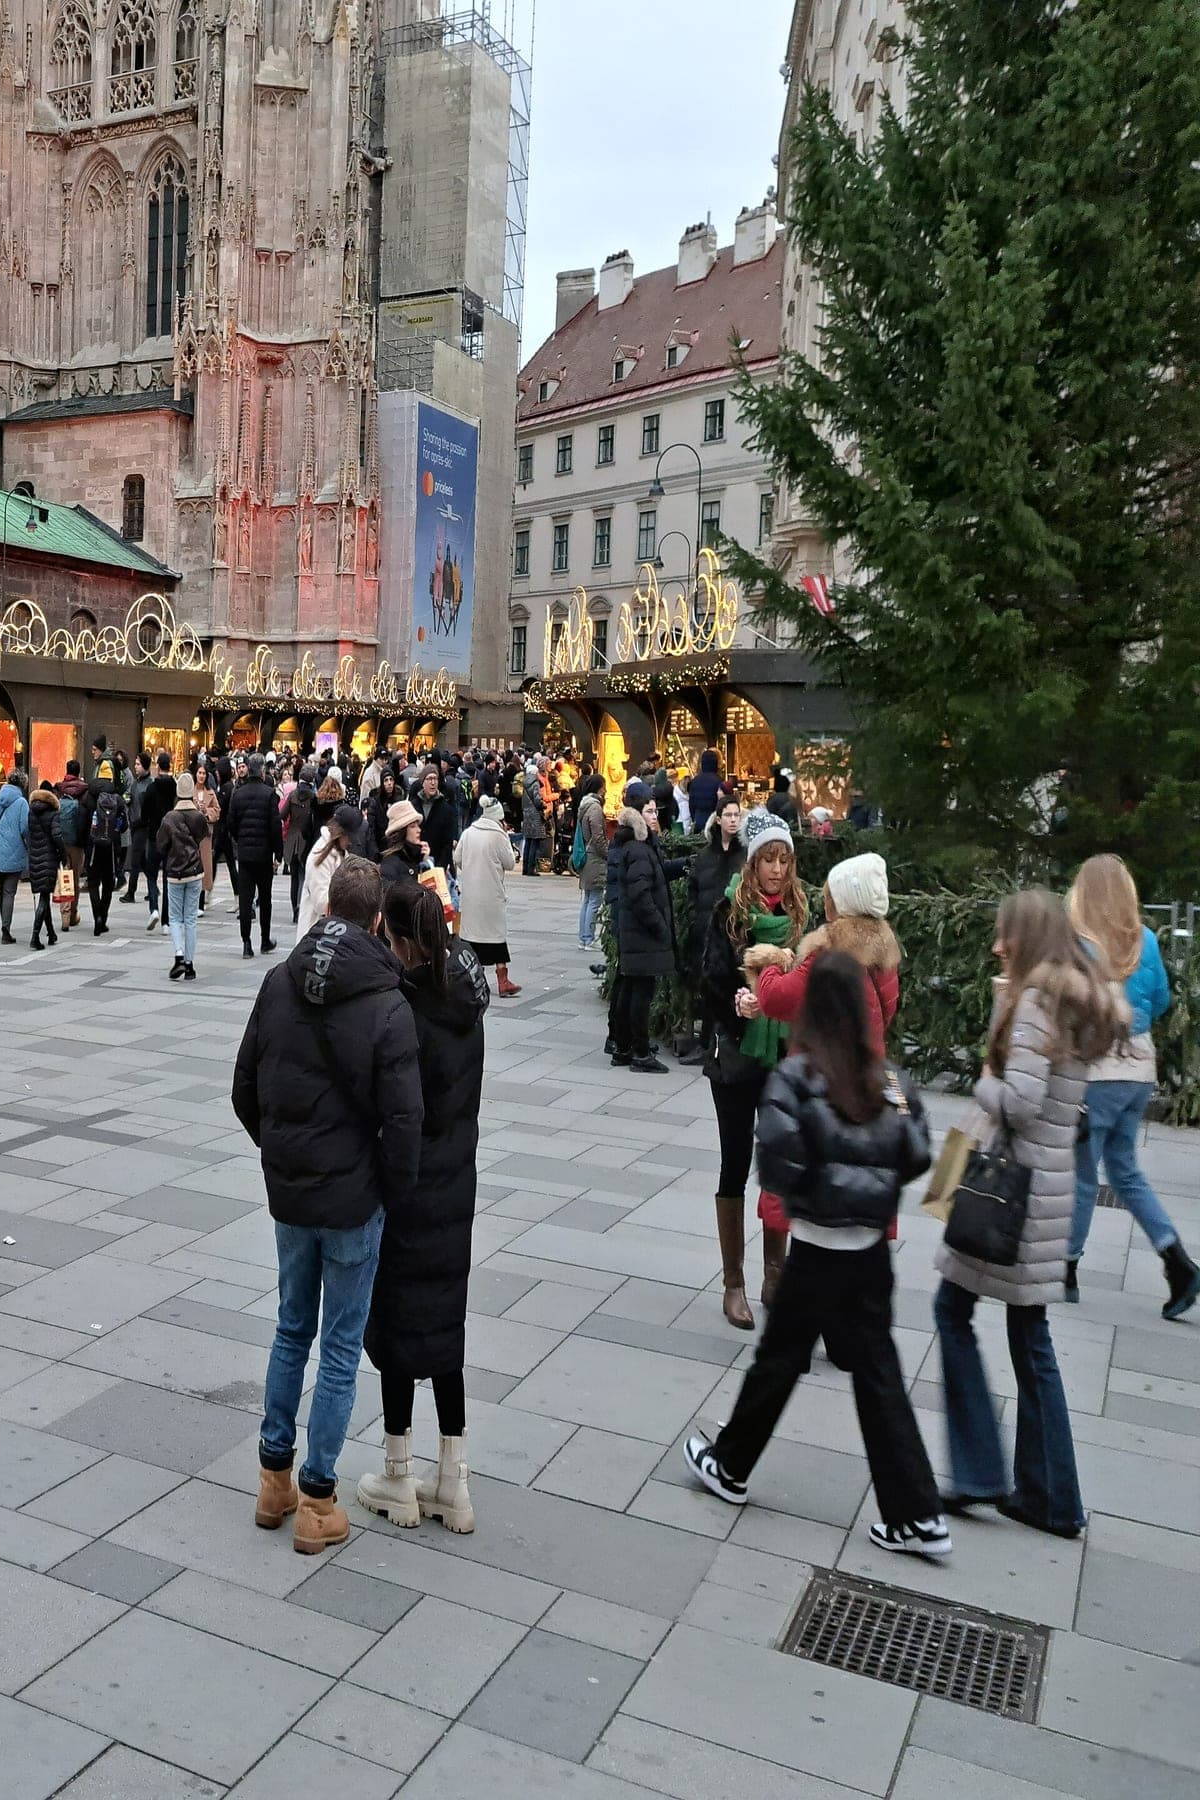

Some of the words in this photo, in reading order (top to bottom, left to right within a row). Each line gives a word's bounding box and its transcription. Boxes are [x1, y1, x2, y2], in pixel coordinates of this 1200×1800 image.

[423, 427, 441, 451] Sharing
[441, 436, 450, 451] the
[450, 441, 467, 457] passion
[422, 444, 431, 460] for
[434, 480, 453, 496] priceless
